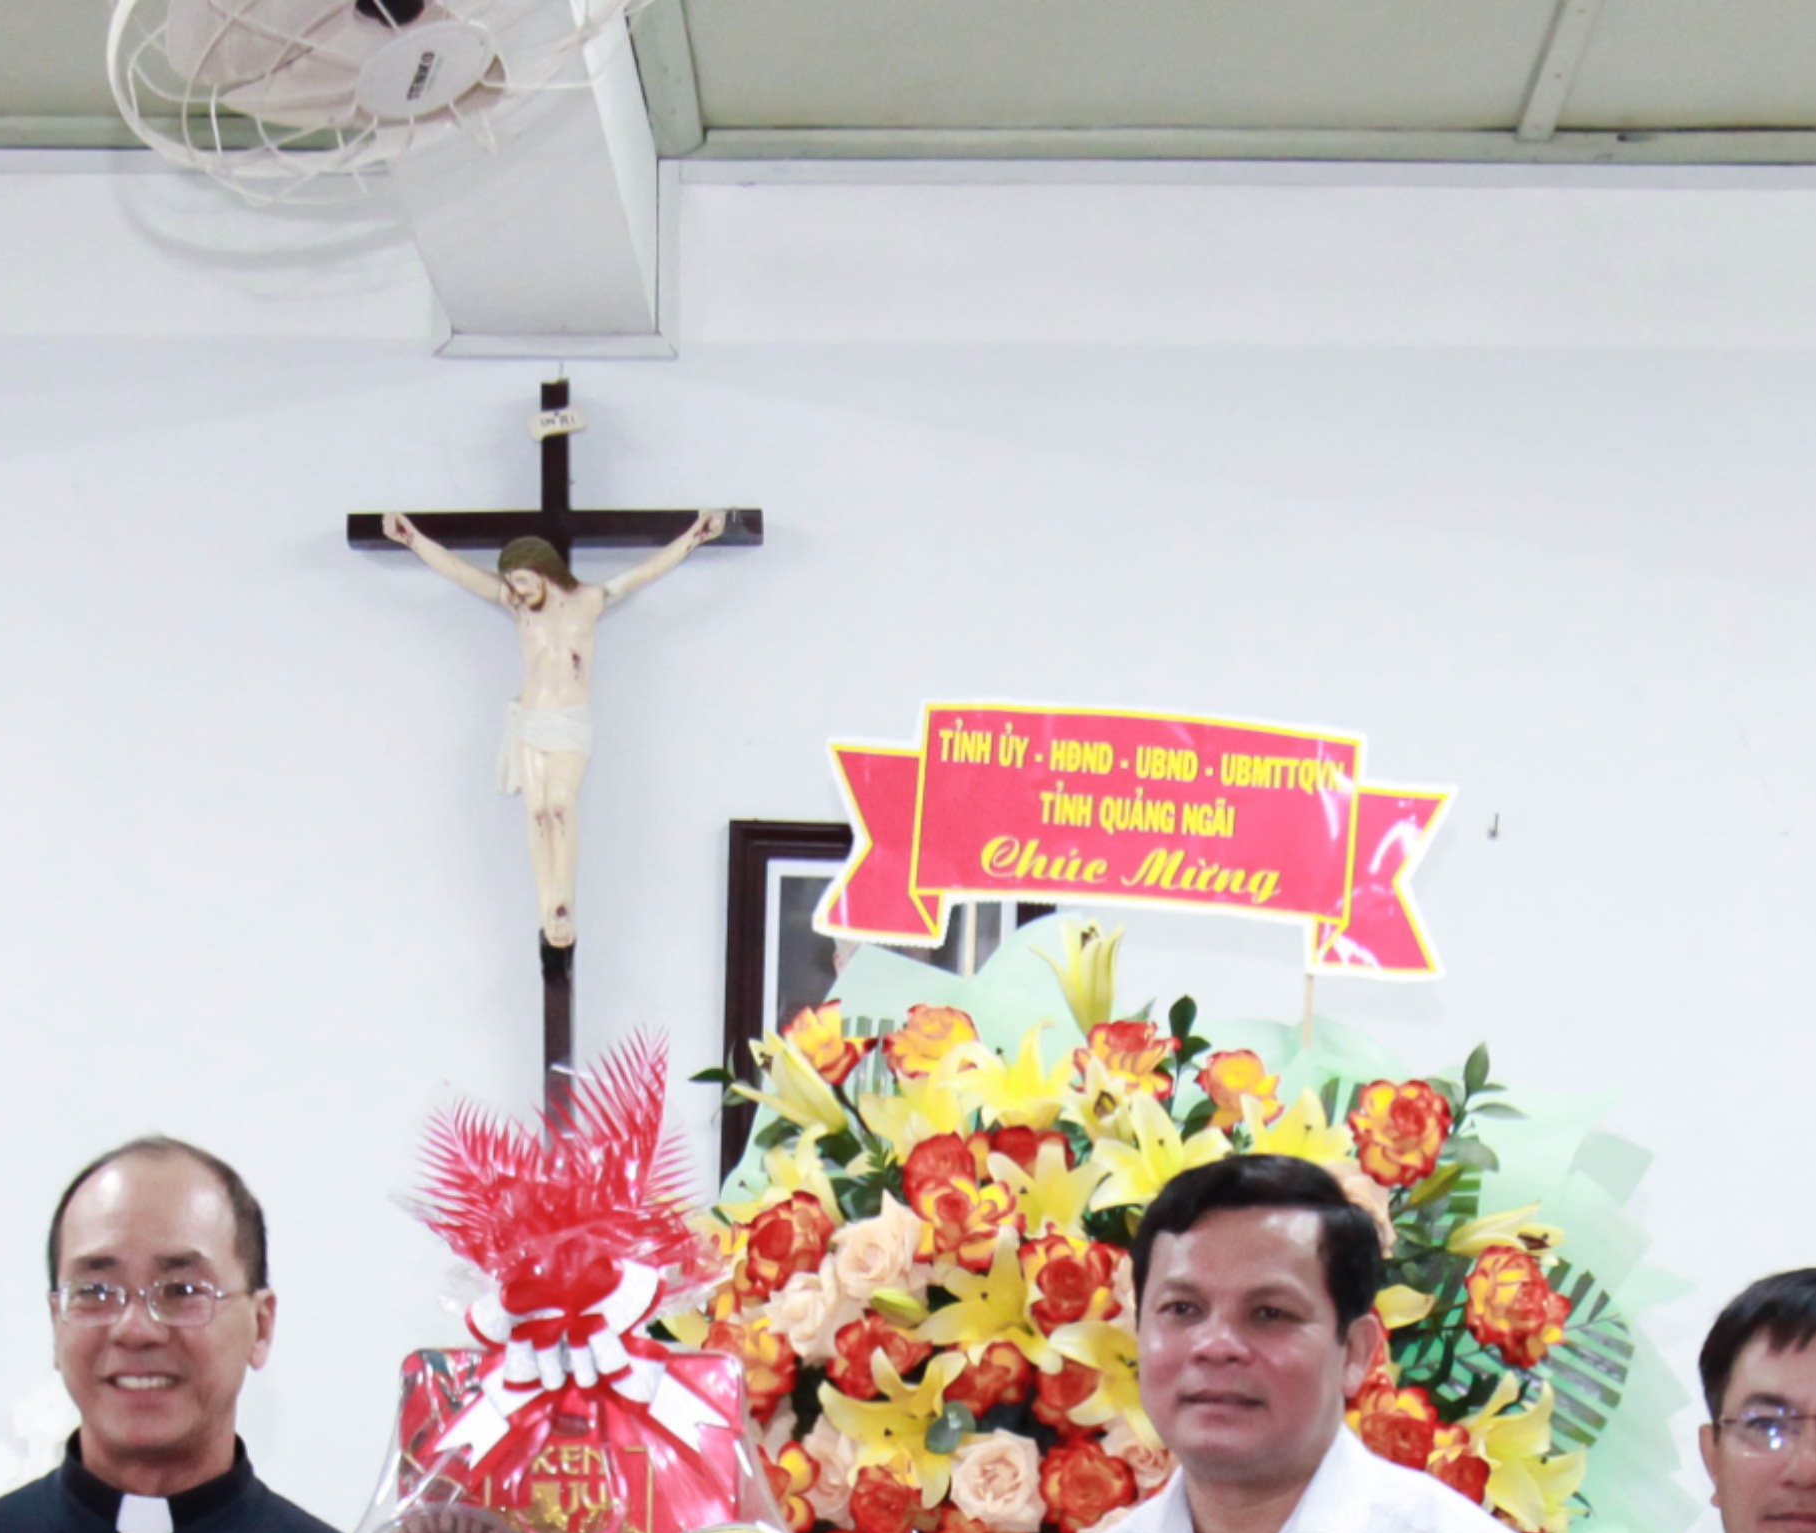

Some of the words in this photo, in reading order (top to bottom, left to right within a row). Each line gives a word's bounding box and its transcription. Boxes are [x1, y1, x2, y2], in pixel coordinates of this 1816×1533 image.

[939, 717, 992, 765] TỈNH
[999, 721, 1029, 769] ỦY
[1050, 739, 1114, 776] HĐND
[1136, 745, 1199, 783] UBND
[1039, 781, 1093, 828] TỈNH
[1099, 787, 1176, 835] QUẢNG
[1181, 797, 1236, 838] NGÃI
[980, 834, 1108, 884] Chúc
[1120, 847, 1282, 904] Mừng
